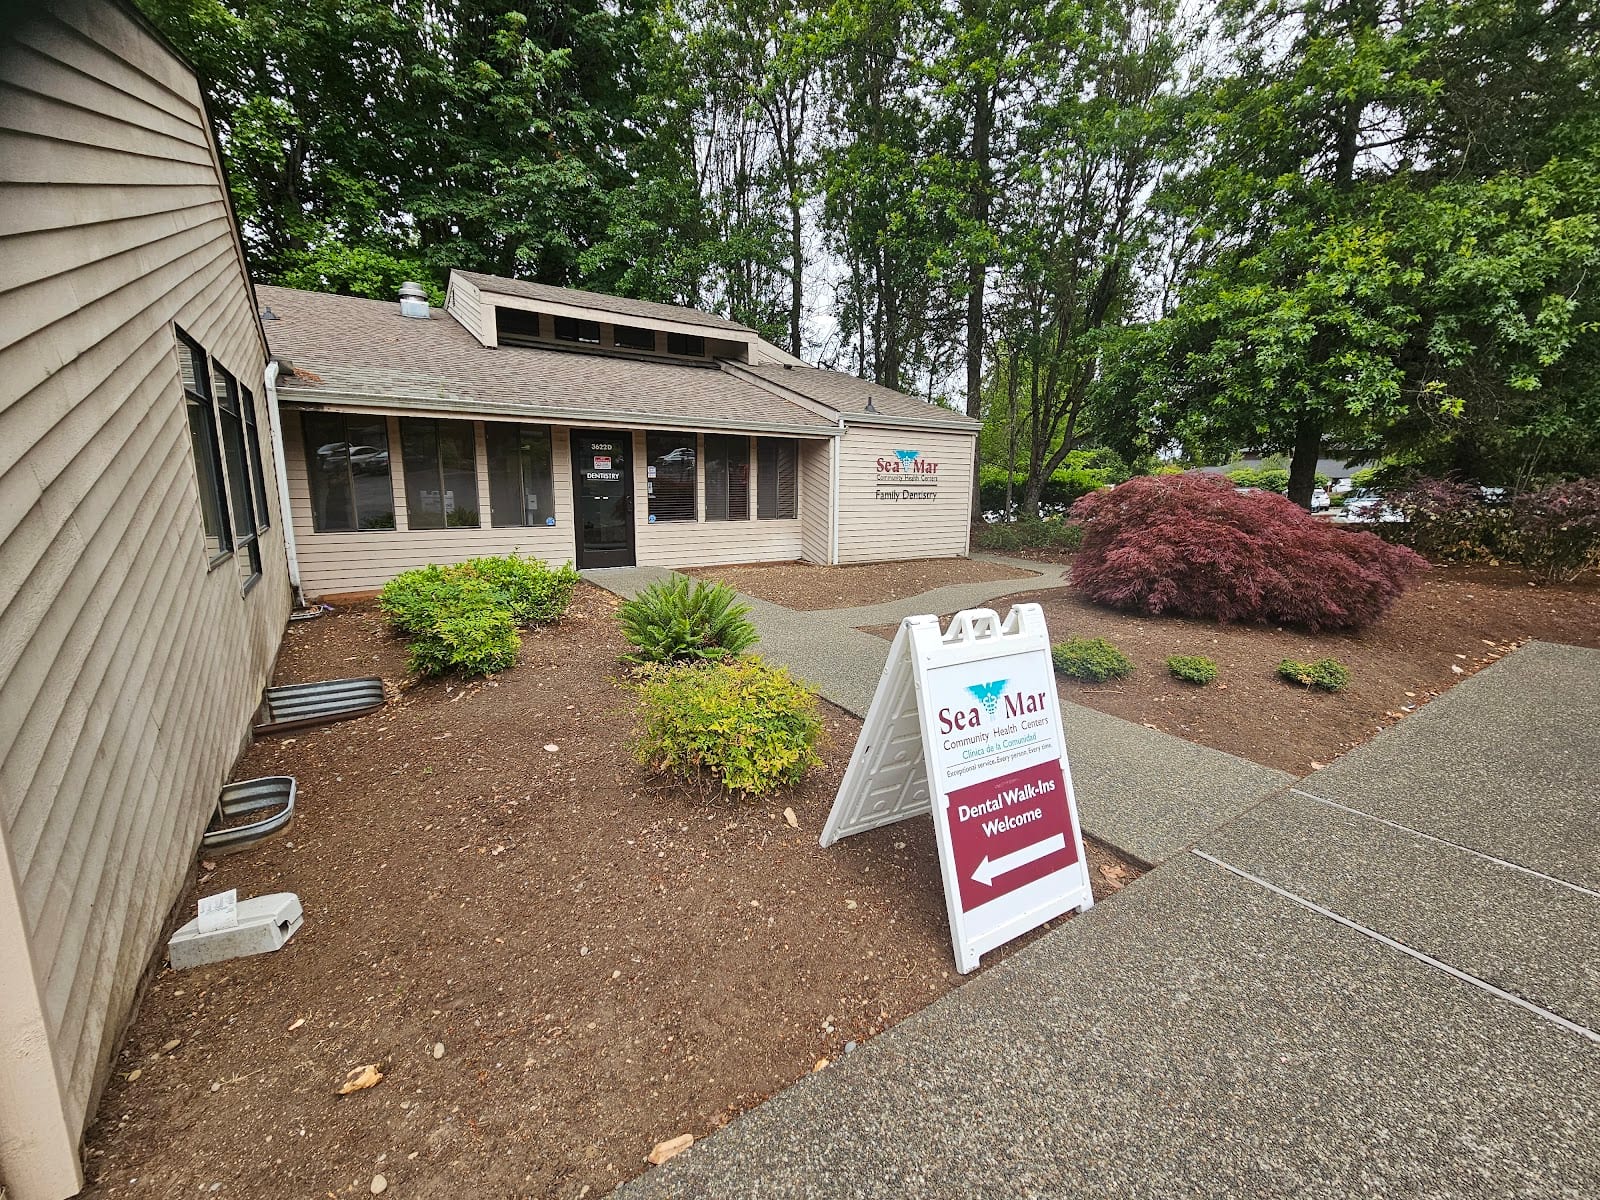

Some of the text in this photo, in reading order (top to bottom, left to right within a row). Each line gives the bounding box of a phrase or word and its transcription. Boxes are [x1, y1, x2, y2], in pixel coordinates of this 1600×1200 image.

[876, 458, 938, 474] Sea Mar
[876, 474, 938, 482] Community Health Centers
[875, 489, 937, 502] Family Dentistry
[938, 692, 1046, 735] Sea Mar
[943, 717, 1049, 751] Community Health Centers
[986, 744, 995, 754] de
[996, 743, 1002, 751] la
[1002, 732, 1037, 749] Comunidad
[946, 763, 977, 778] Exceptional
[978, 760, 996, 770] service.
[996, 755, 1010, 767] Every
[1028, 746, 1041, 757] Every
[958, 779, 1056, 822] Dental Walk-Ins
[981, 807, 1042, 838] Welcome
